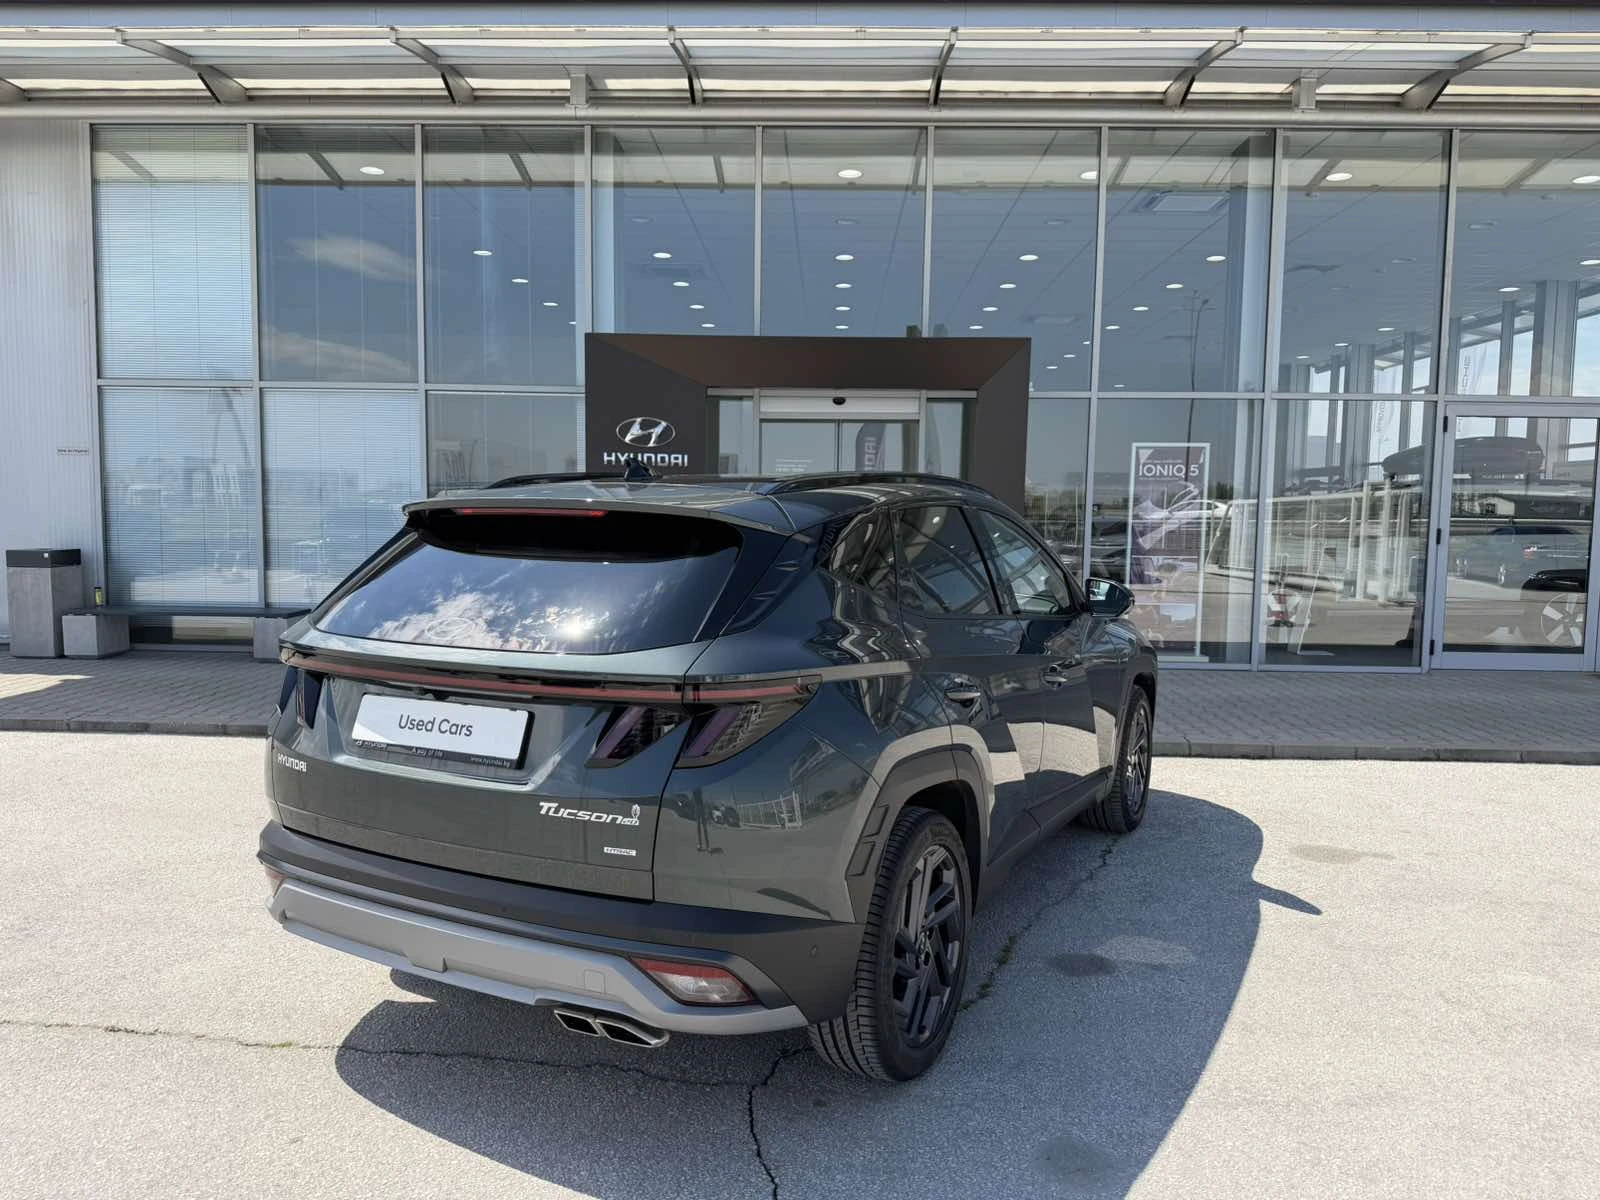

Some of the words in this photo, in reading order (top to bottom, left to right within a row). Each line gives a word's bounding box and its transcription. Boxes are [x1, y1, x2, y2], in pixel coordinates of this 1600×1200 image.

[1139, 464, 1186, 478] IONIQ
[1189, 463, 1200, 477] 5
[398, 714, 434, 733] Used
[438, 716, 473, 737] Cars
[277, 753, 308, 773] HYUNDAI
